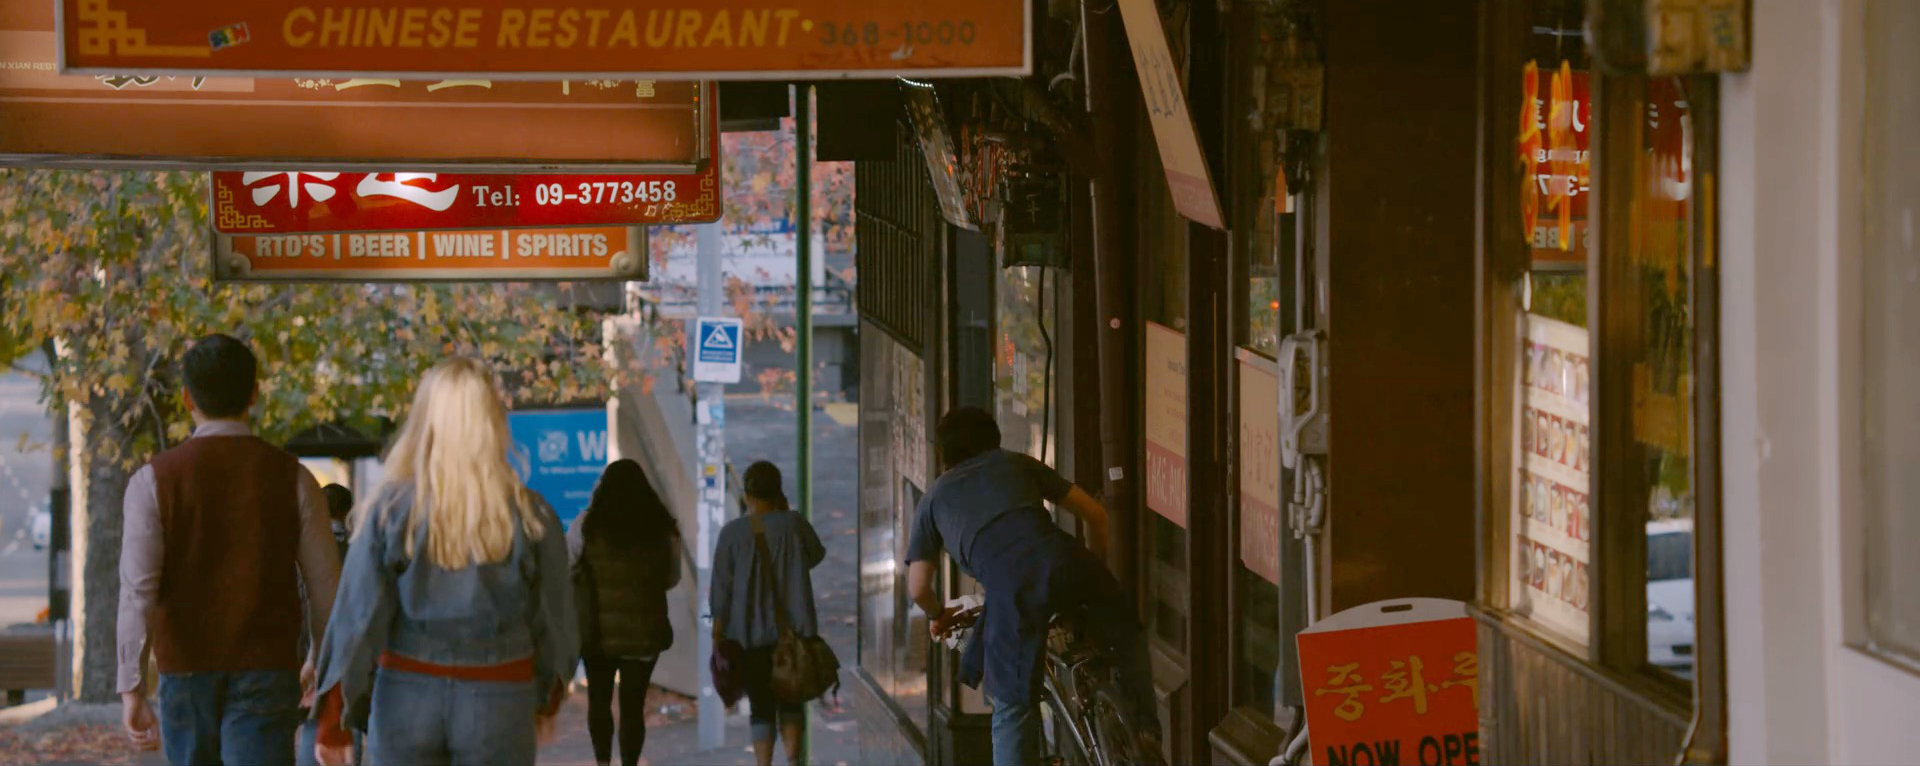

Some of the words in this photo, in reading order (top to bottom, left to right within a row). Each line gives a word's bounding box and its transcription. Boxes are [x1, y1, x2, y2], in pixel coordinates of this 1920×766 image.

[282, 8, 483, 47] CHINESE
[498, 8, 798, 47] RESTAURANT
[819, 20, 977, 46] 368-1000
[472, 185, 520, 207] Tel:
[535, 180, 676, 205] 09-3773458
[255, 235, 325, 257] RTD'S
[350, 234, 410, 257] BEER
[433, 234, 494, 257] WINE
[517, 234, 607, 256] SPIRITS
[1328, 740, 1400, 766] NOW
